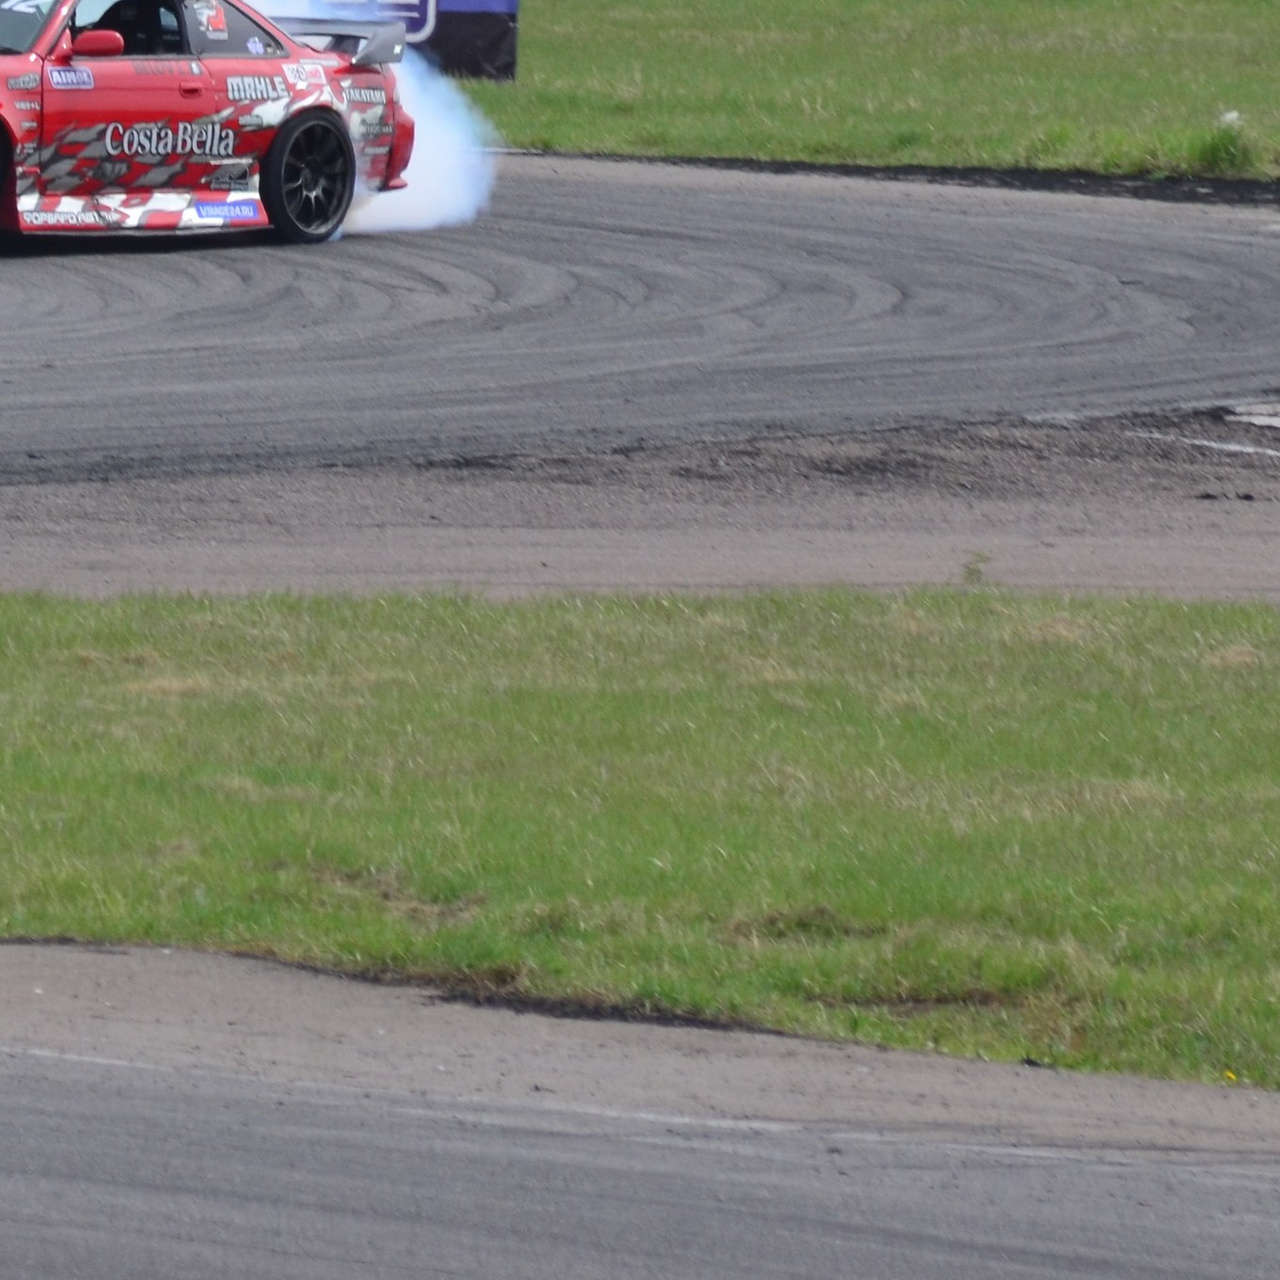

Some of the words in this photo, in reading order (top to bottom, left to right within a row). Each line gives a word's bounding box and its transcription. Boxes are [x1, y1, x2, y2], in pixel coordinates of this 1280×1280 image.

[226, 76, 289, 100] MAHLE
[345, 88, 387, 104] TAKAYAMA
[105, 122, 173, 155] Costa
[176, 122, 234, 156] Bella
